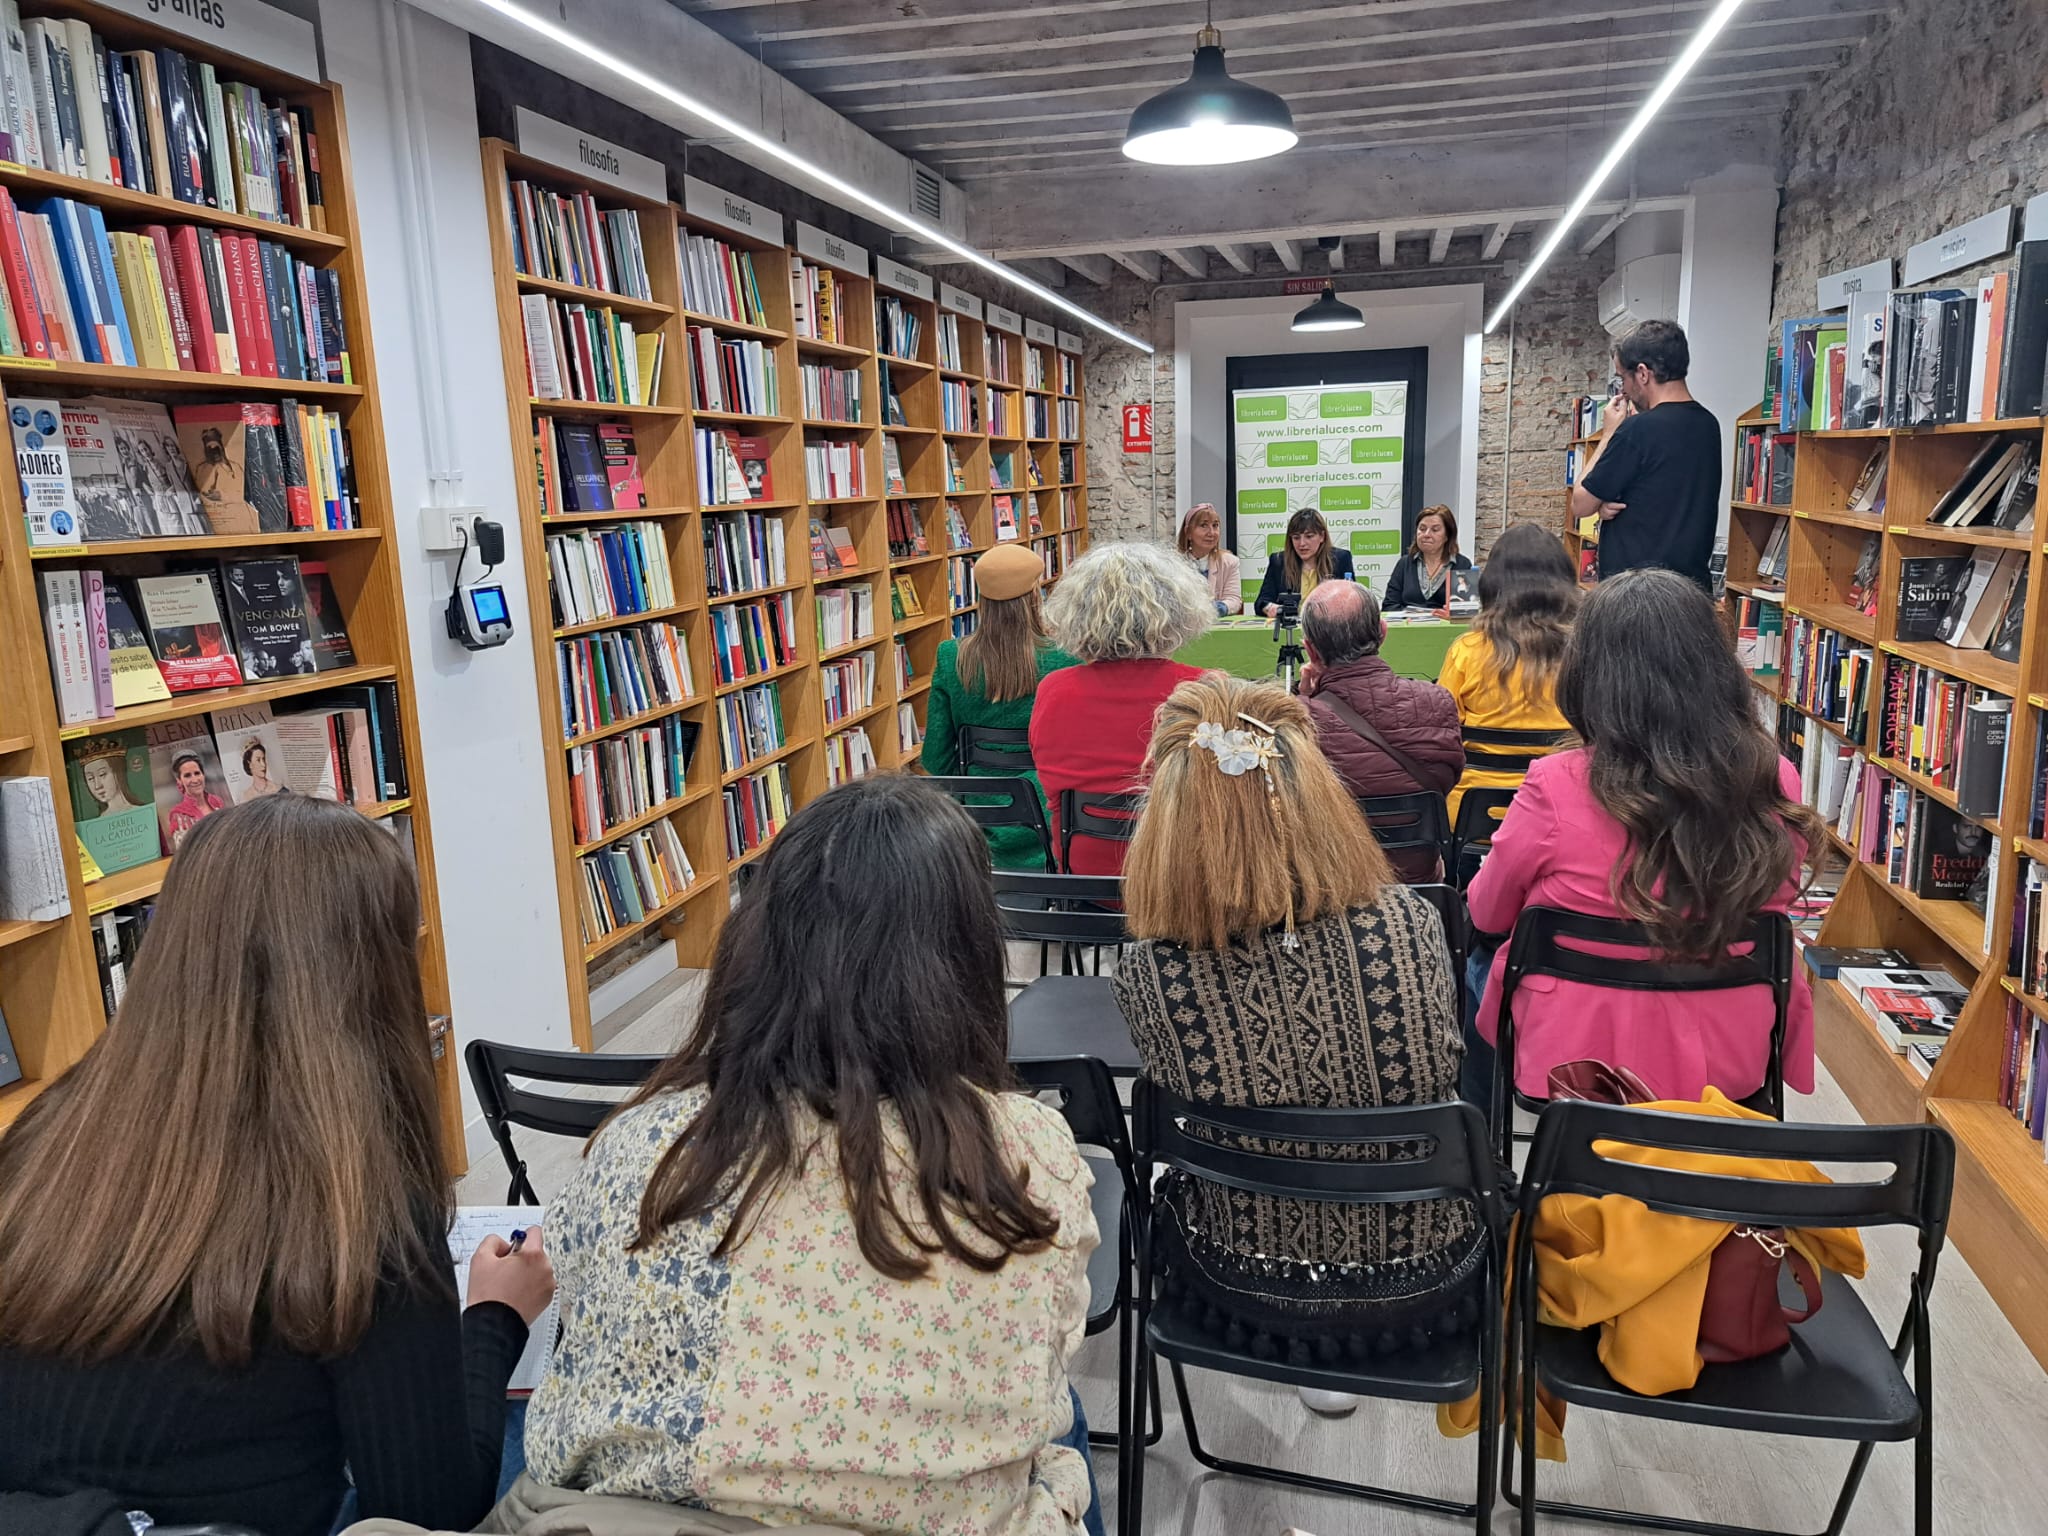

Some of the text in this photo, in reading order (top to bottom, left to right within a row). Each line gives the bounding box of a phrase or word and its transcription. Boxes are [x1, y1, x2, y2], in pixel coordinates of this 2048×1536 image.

[229, 240, 245, 285] CHANG
[247, 243, 264, 287] CHANG
[1301, 279, 1331, 292] SALID
[1257, 423, 1383, 438] www.librerialuces.com
[19, 453, 63, 476] ADORES
[1257, 470, 1382, 484] www.librerialuces.com
[1907, 588, 1952, 602] Sabin
[92, 579, 107, 649] DIVAS
[237, 607, 305, 622] VENGANZA
[247, 623, 300, 634] TOM BOWER
[111, 655, 129, 664] esito
[119, 665, 130, 673] de
[1885, 667, 1904, 751] MAVERICK
[108, 816, 136, 831] ISABEL
[95, 823, 149, 845] LA CATÓLICA
